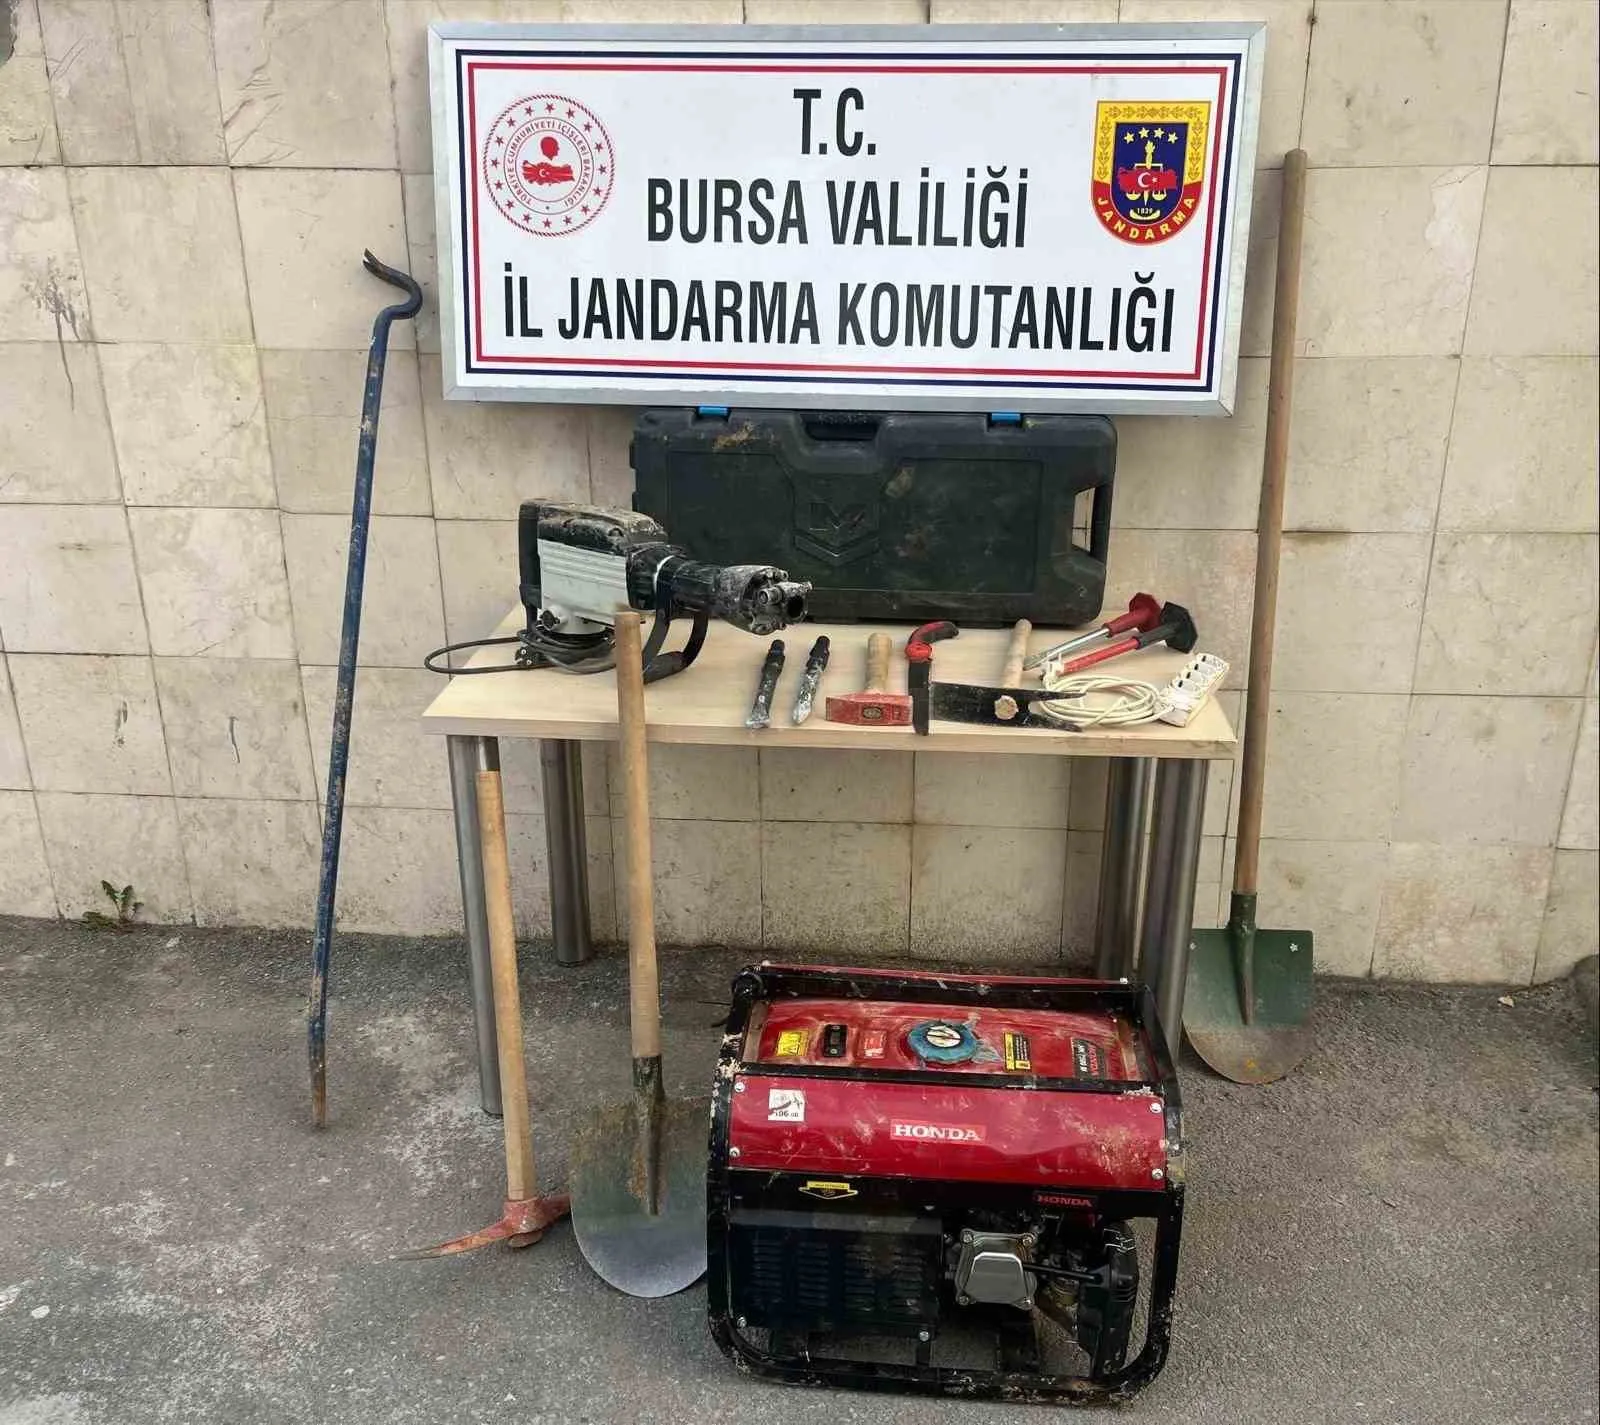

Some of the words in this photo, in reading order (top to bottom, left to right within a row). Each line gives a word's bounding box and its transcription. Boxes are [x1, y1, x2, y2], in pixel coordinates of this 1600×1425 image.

[793, 88, 876, 156] T.C.
[647, 178, 809, 245] BURSA
[825, 165, 1028, 249] VALİLİĞİ
[1097, 197, 1195, 240] JANDARMA
[504, 262, 543, 338] İL
[558, 277, 820, 345] JANDARMA
[838, 271, 1175, 354] KOMUTANLIĞI
[895, 1123, 982, 1142] HONDA
[1037, 1193, 1093, 1208] HONDA
